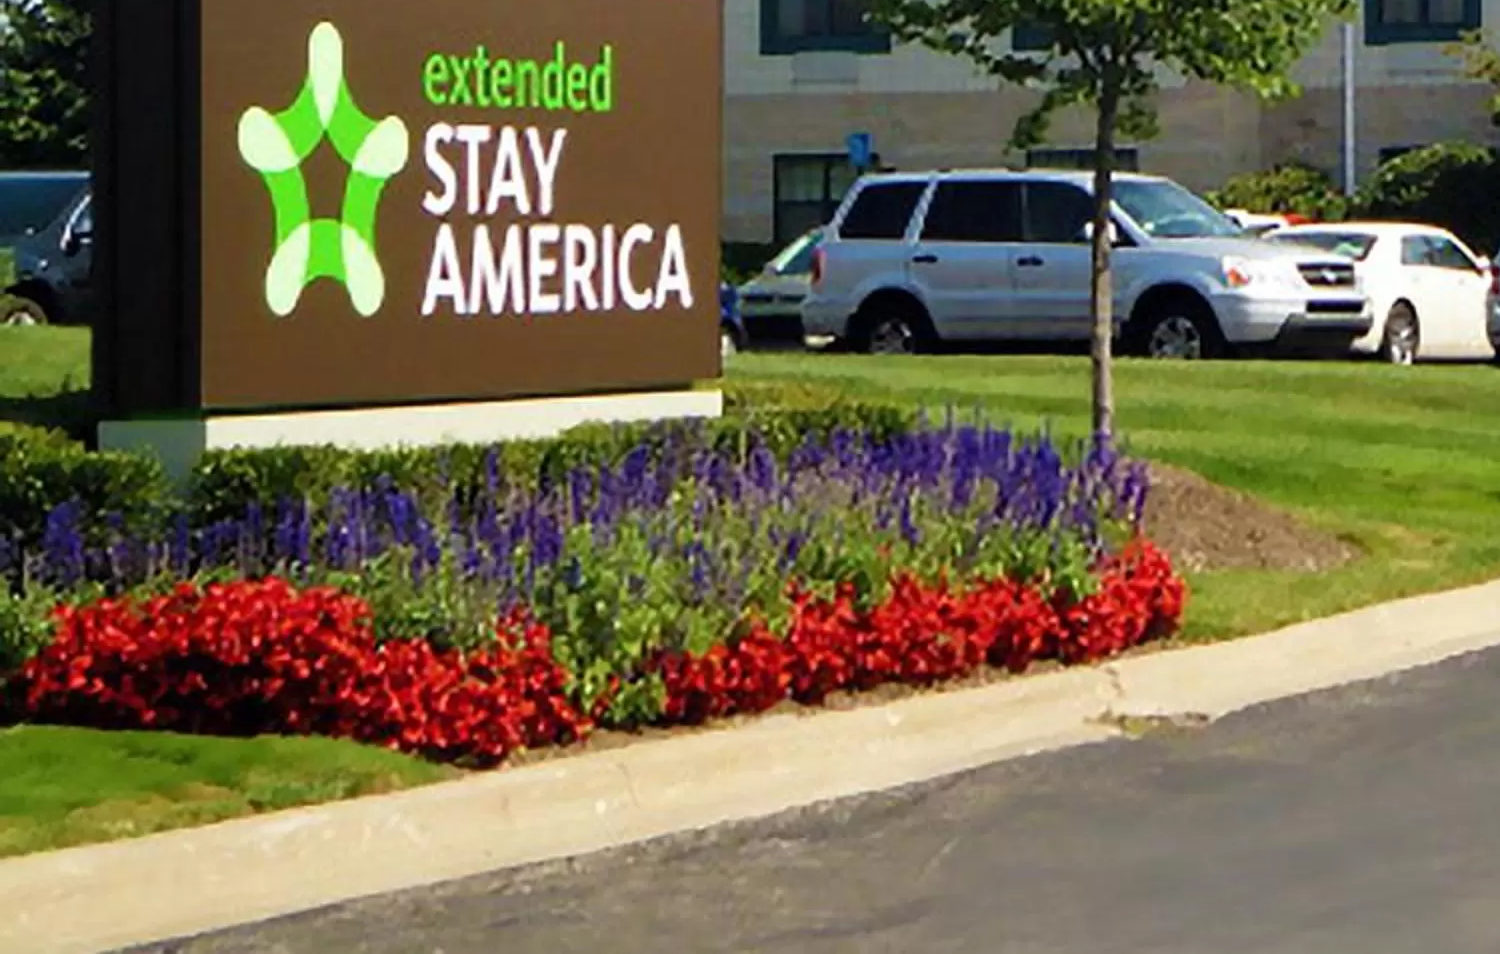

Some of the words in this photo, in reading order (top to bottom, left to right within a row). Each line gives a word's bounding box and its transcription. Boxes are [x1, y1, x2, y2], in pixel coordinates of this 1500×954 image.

[421, 41, 614, 113] extended
[421, 122, 567, 216] STAY
[421, 222, 694, 316] AMERICA
